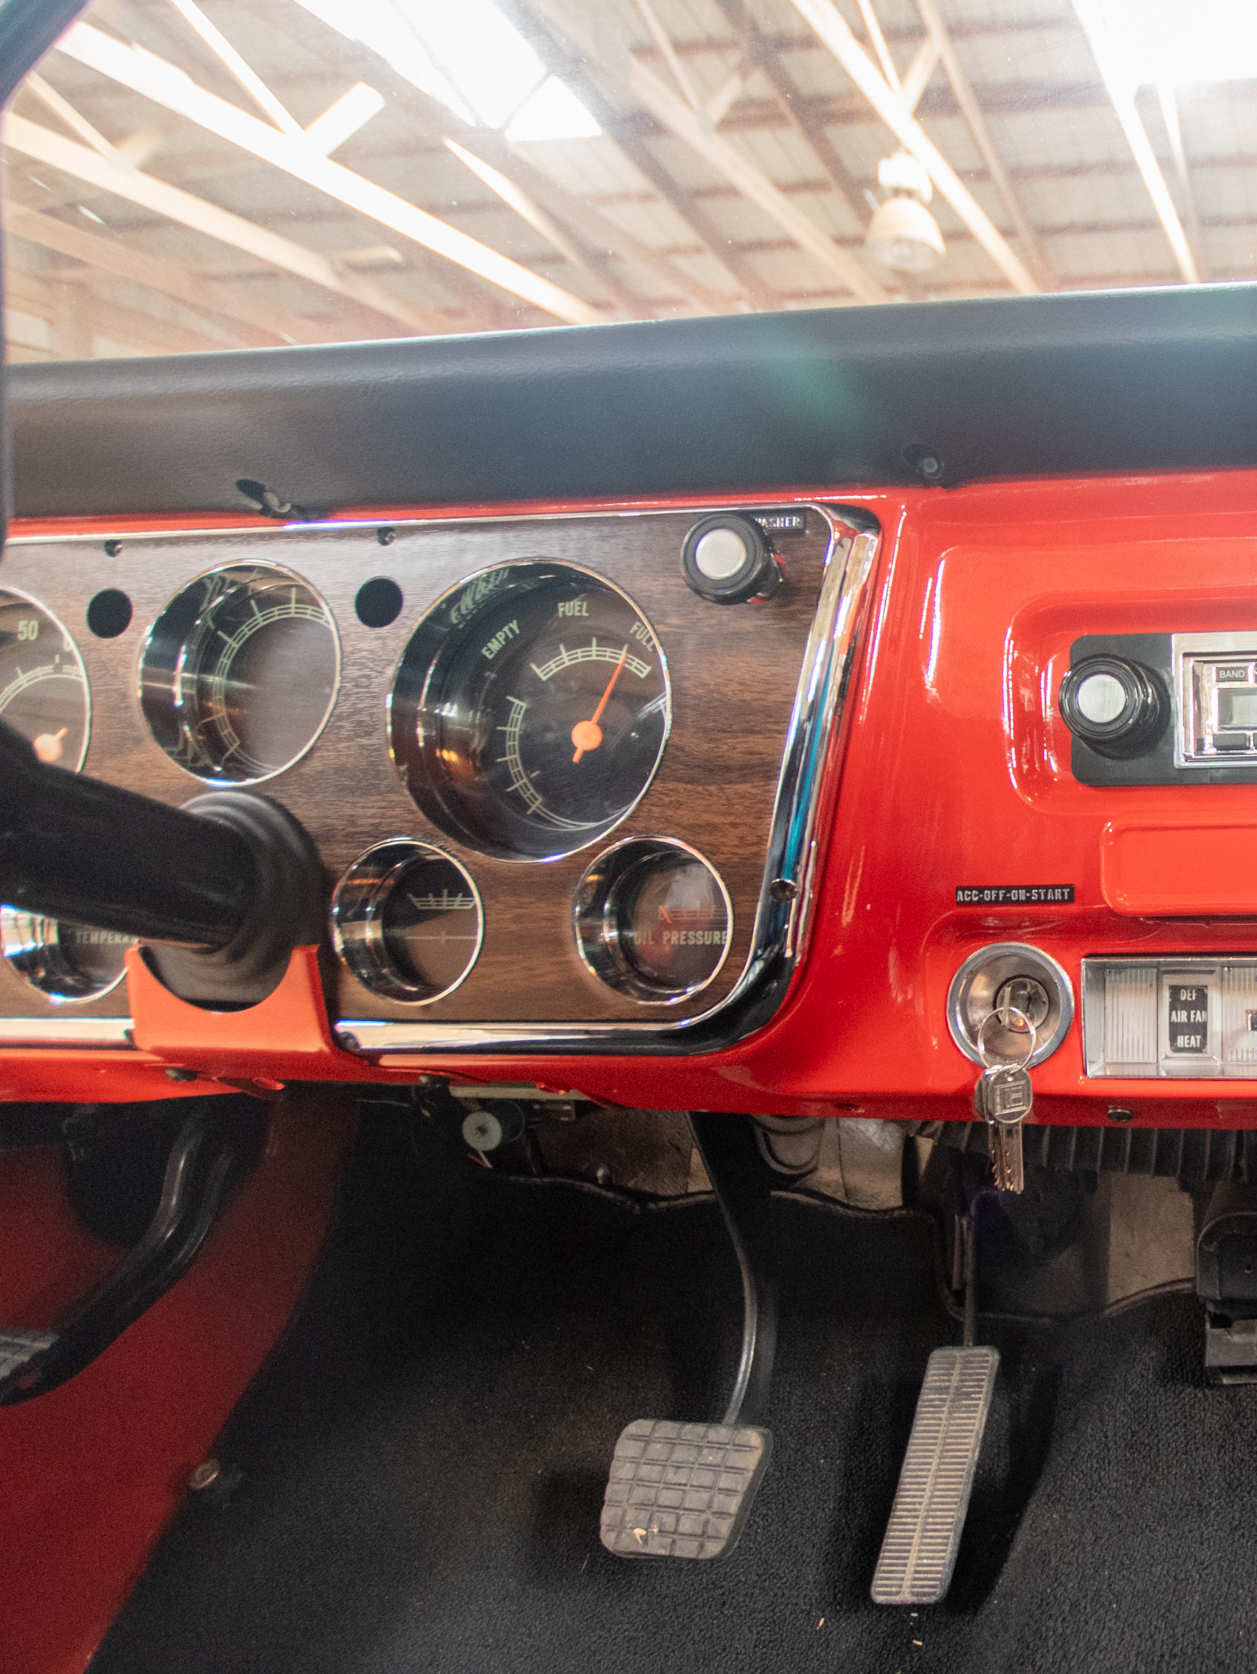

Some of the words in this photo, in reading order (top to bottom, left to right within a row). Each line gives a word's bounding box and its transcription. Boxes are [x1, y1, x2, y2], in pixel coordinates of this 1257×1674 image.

[557, 601, 590, 618] FUEL
[17, 620, 39, 641] 50
[629, 621, 656, 652] FULL
[481, 619, 521, 660] EMPTY
[1219, 669, 1246, 679] BAND
[633, 930, 655, 946] OIL
[662, 930, 728, 946] PRESSURE
[1180, 988, 1197, 1001] DEF
[1170, 1010, 1188, 1023] AIR
[1190, 1010, 1208, 1023] FAN
[1177, 1035, 1202, 1048] HEAT
